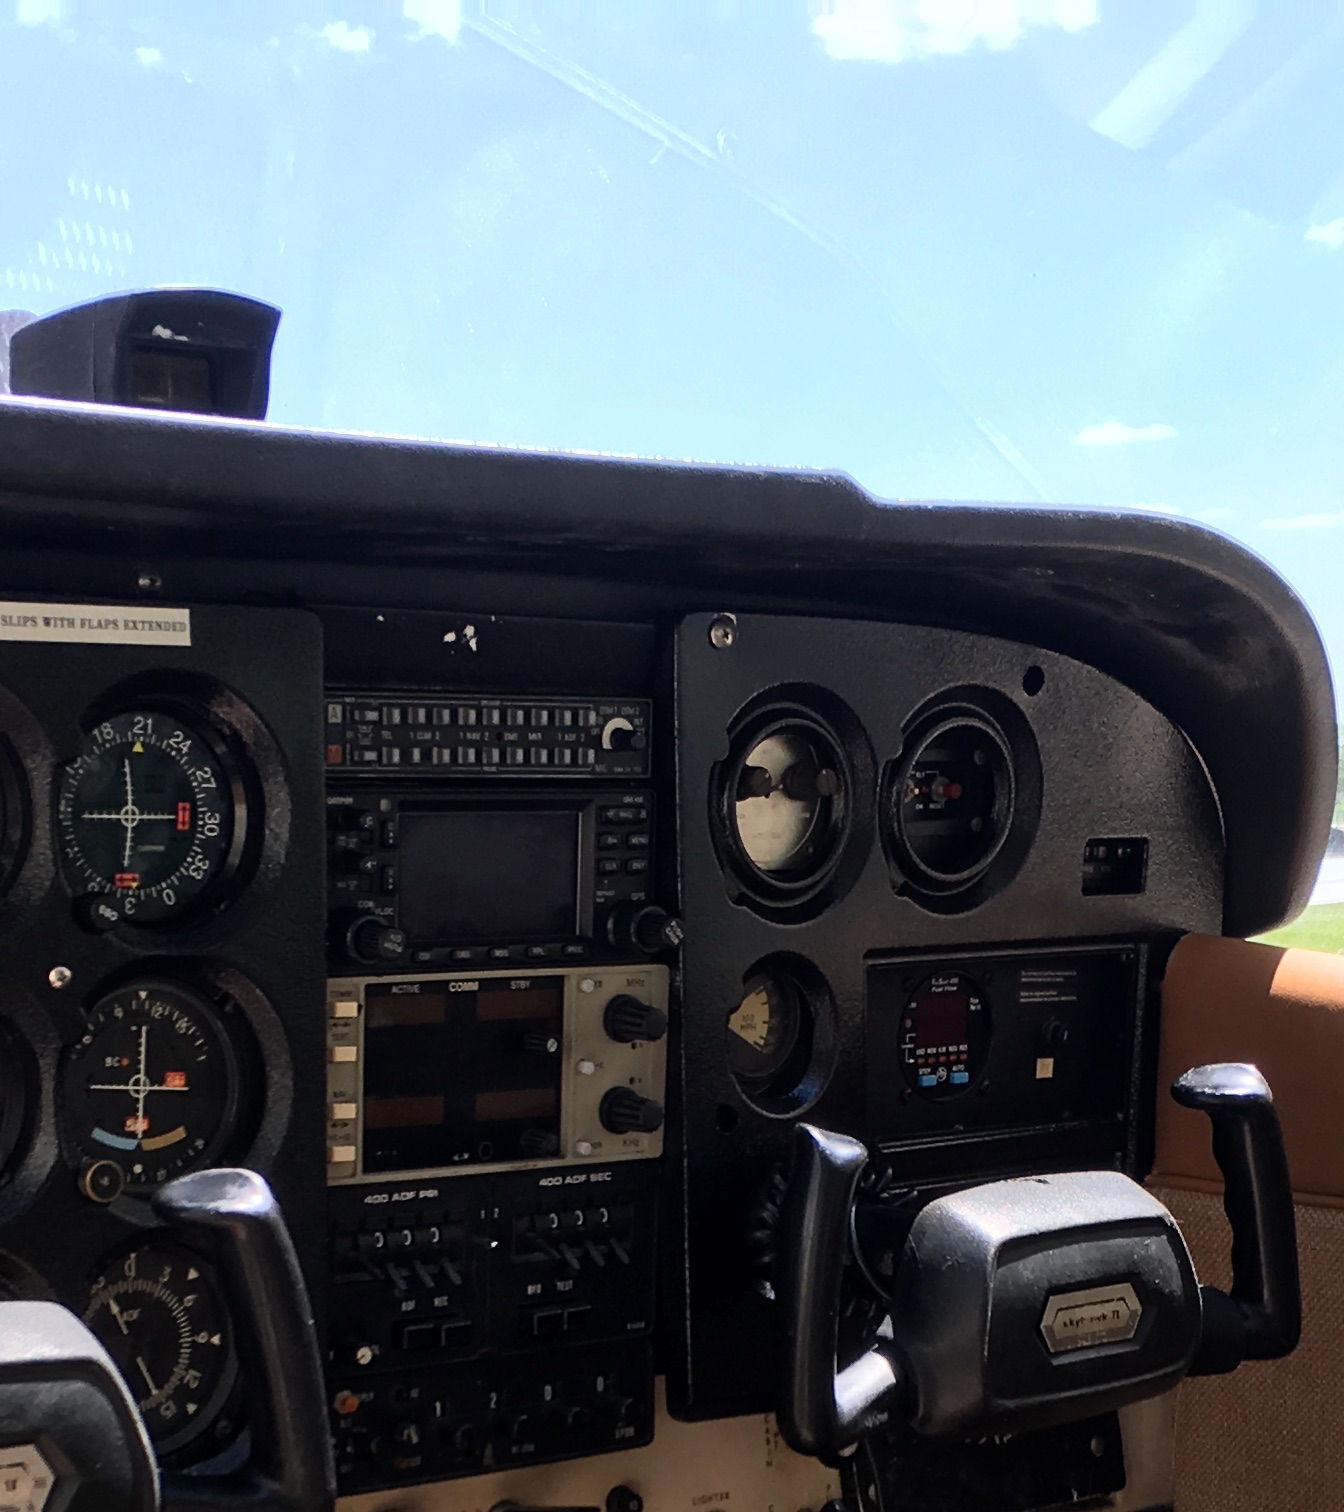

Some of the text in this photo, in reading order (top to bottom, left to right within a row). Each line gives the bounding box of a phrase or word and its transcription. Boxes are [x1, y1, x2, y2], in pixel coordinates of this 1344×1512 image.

[0, 614, 38, 628] SLIPS
[42, 616, 75, 630] WITH
[80, 618, 119, 631] FLAPS
[123, 619, 188, 633] EXTENDED
[92, 722, 114, 744] 18
[132, 716, 154, 735] 21
[169, 731, 192, 754] 24
[195, 766, 217, 789] 27
[204, 812, 221, 837] 30
[188, 854, 210, 880] 33
[124, 897, 136, 915] 3
[390, 984, 421, 994] ACTIVE
[539, 1171, 612, 1187] 400 ADF SEC
[363, 1193, 390, 1204] 400
[391, 1190, 417, 1202] ADF
